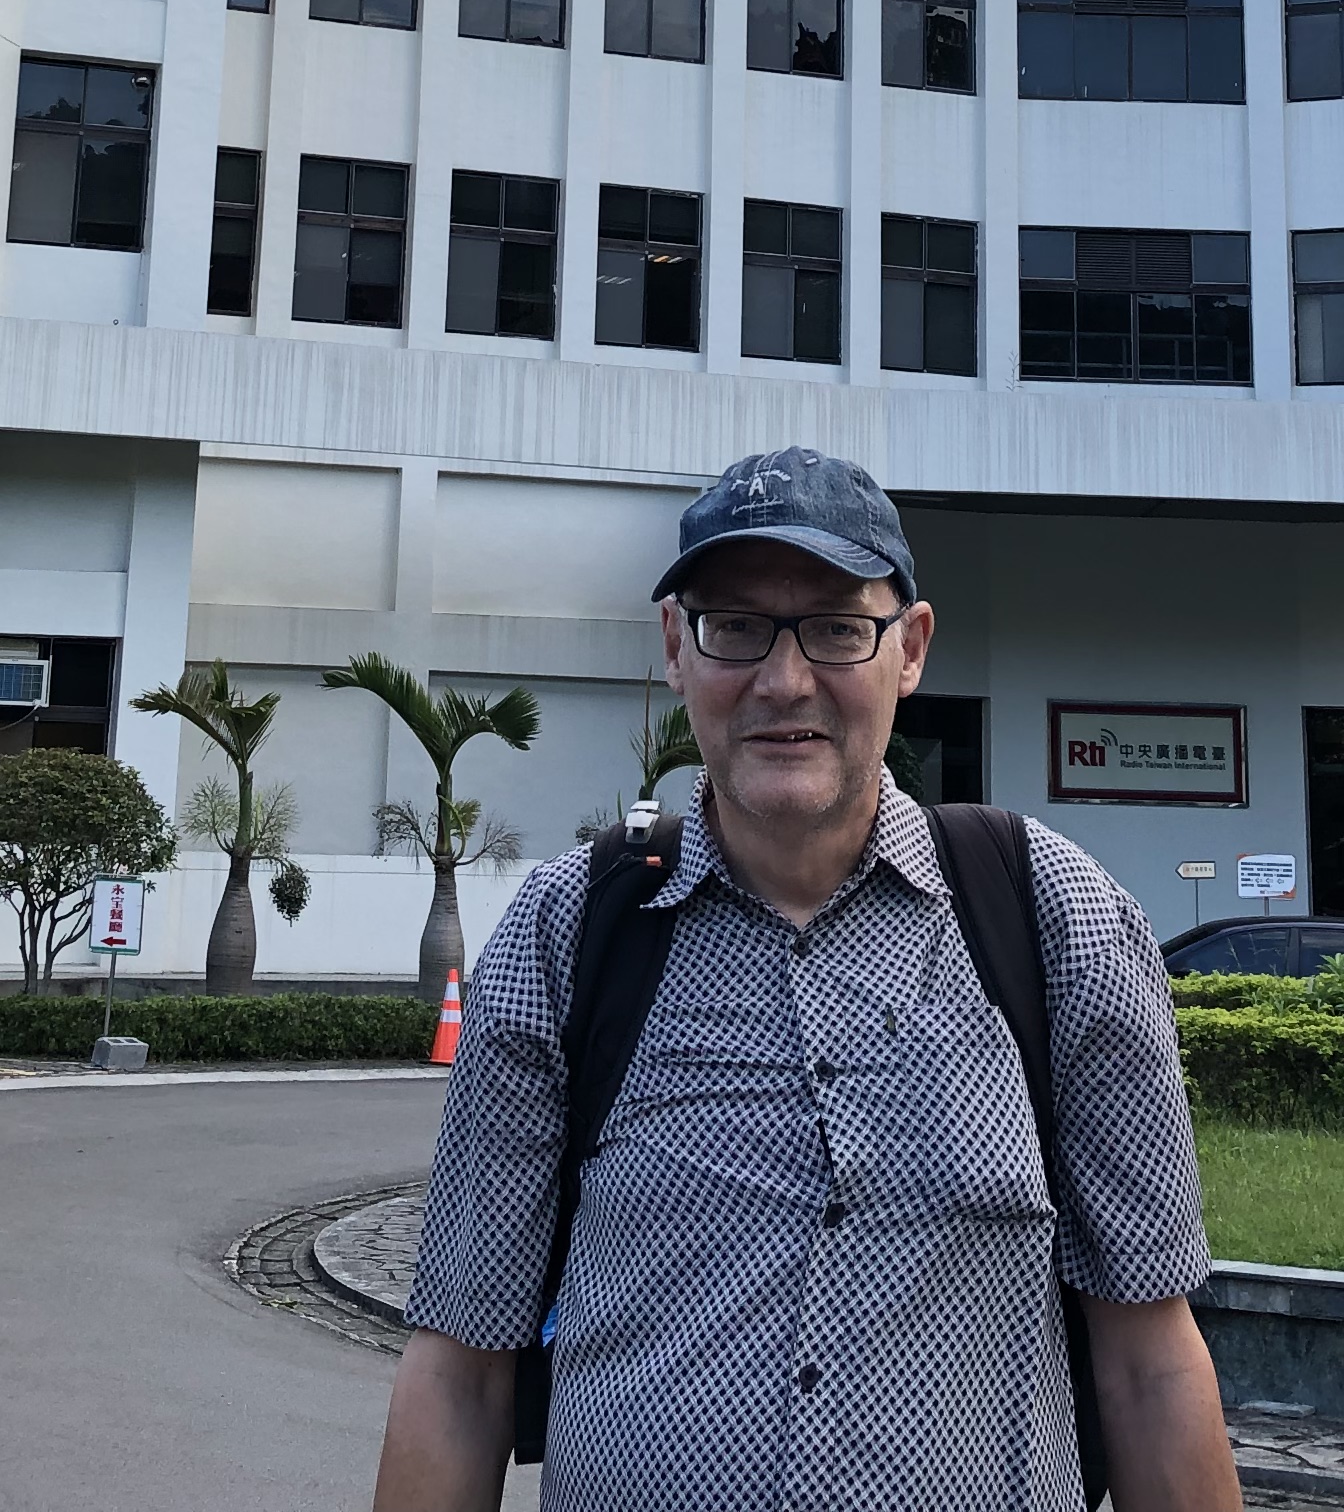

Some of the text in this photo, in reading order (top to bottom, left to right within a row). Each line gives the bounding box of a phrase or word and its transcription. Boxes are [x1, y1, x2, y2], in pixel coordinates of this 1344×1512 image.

[1120, 759, 1226, 771] Radio Taiwan International
